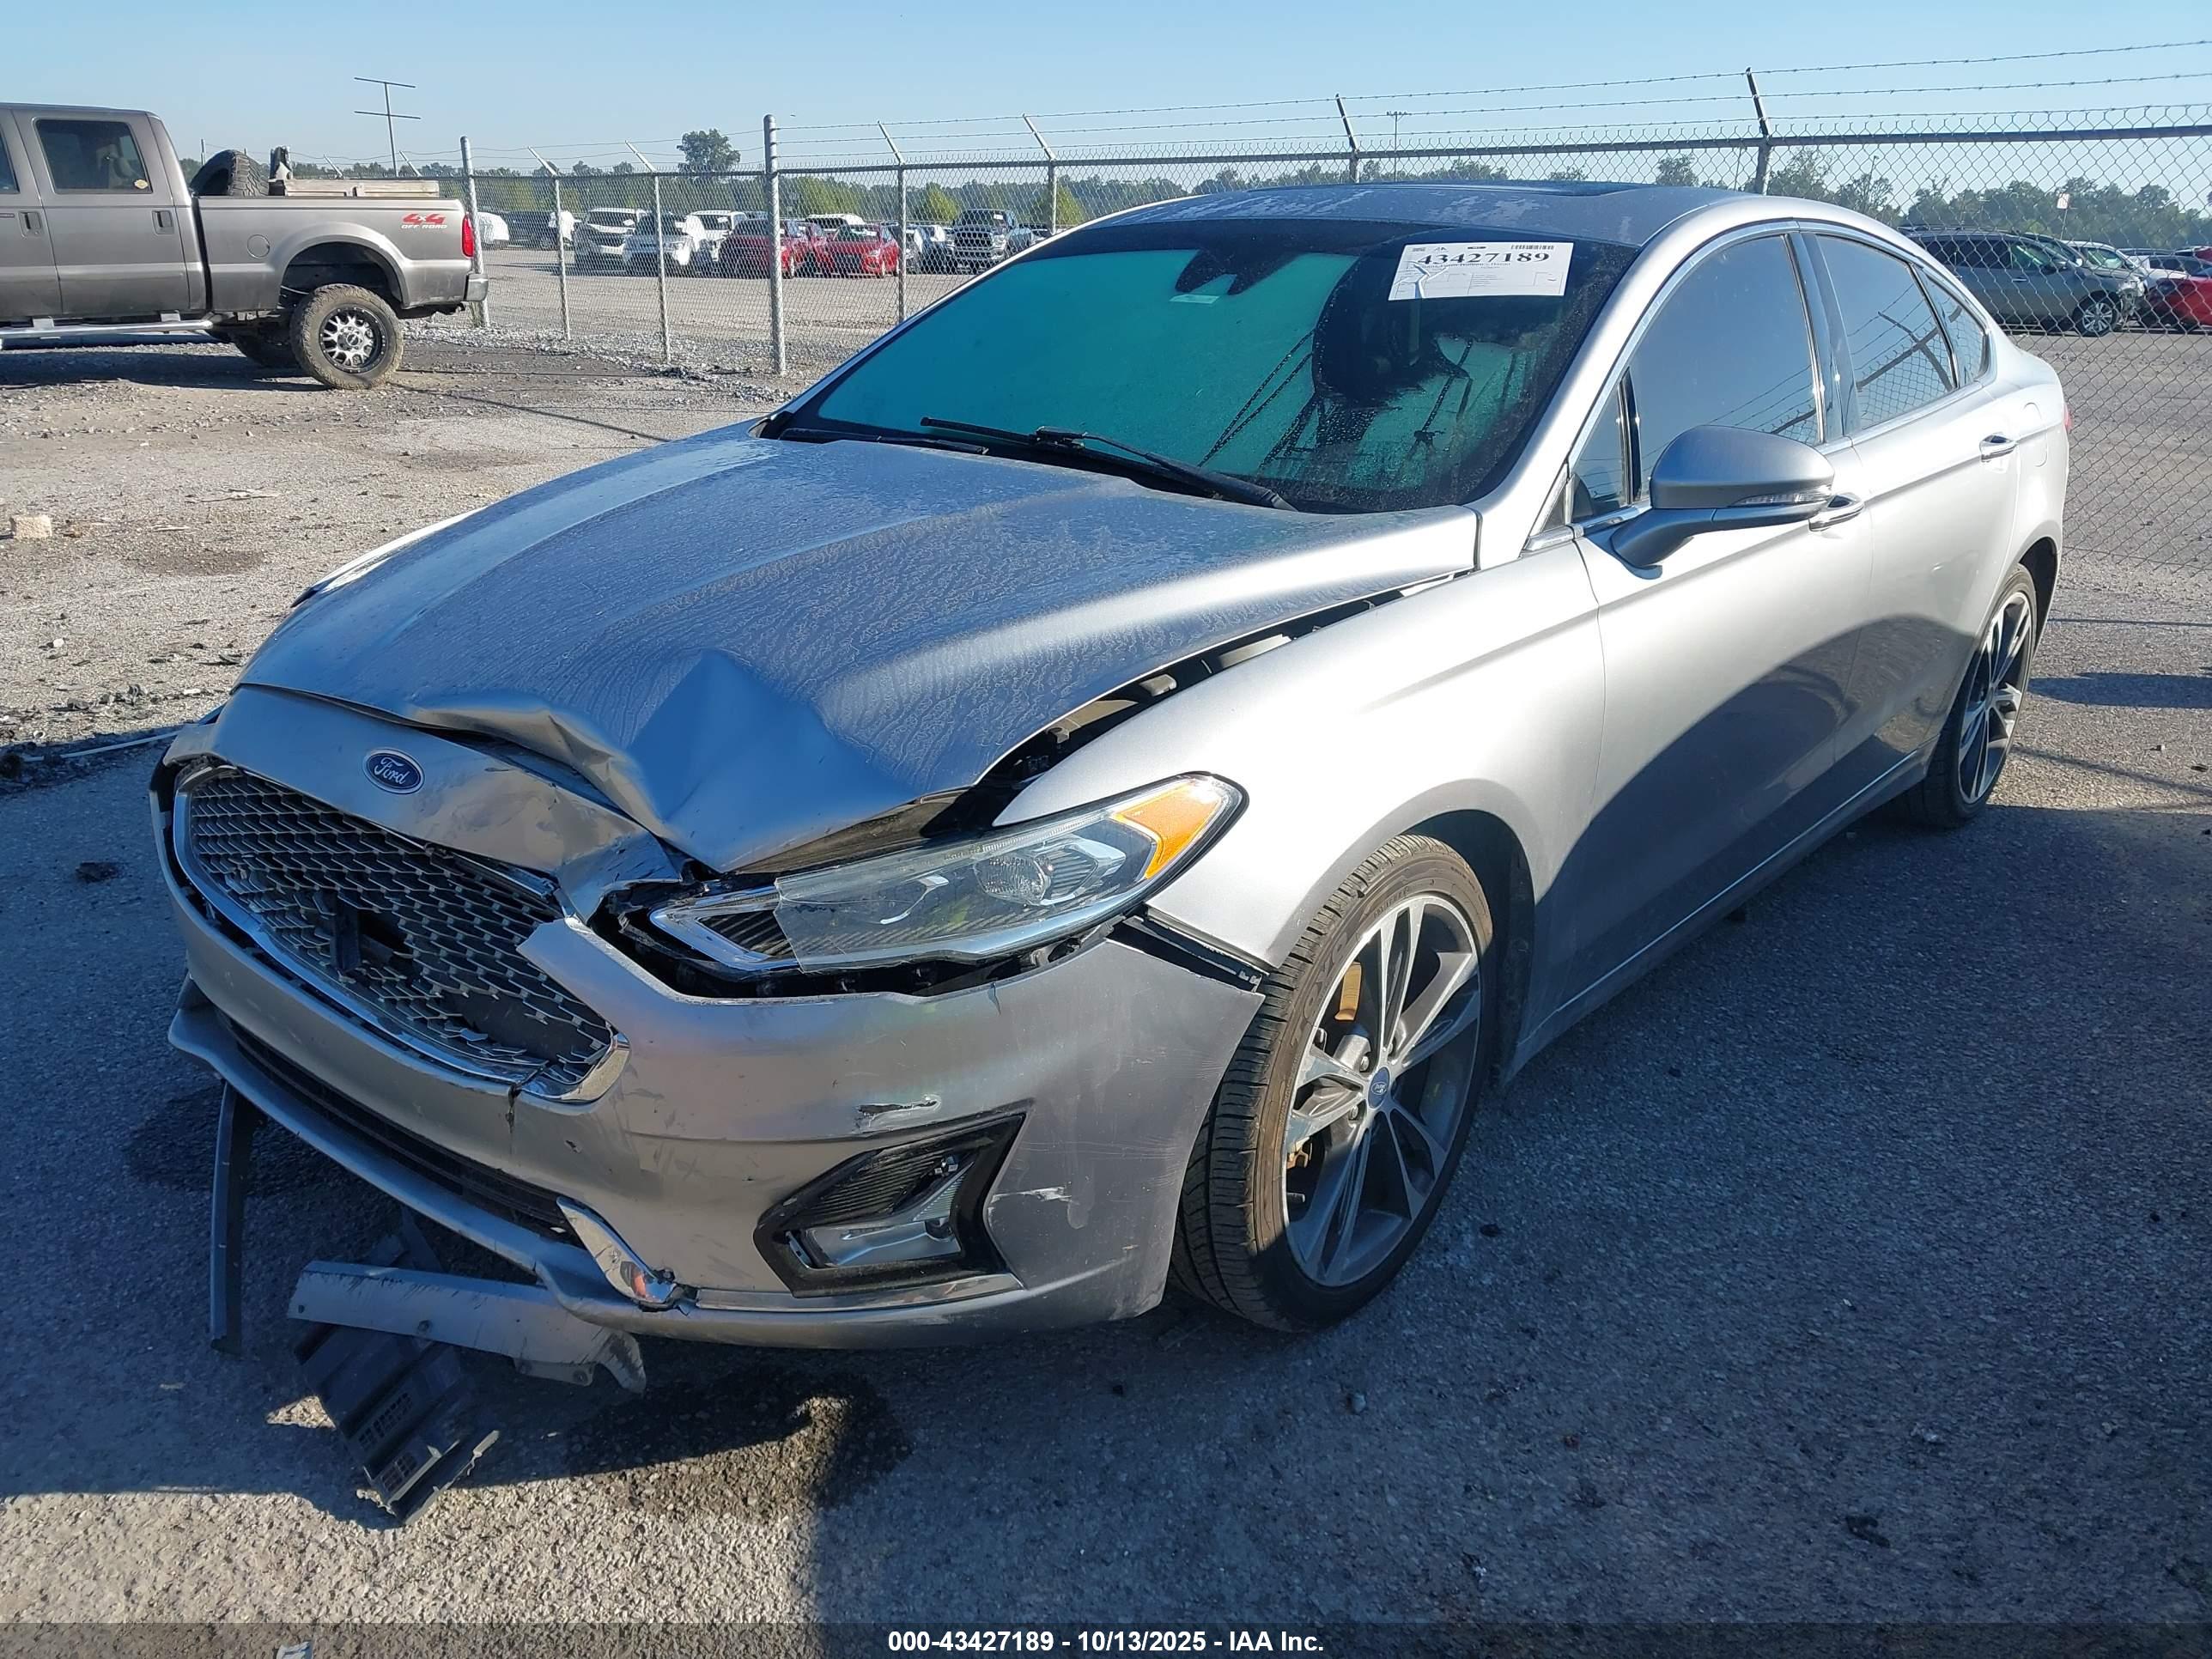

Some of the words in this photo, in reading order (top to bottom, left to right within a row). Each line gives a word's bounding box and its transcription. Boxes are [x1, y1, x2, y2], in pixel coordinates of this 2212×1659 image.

[402, 213, 446, 225] 4x4
[1417, 252, 1550, 264] 43427189
[374, 757, 410, 785] Ford
